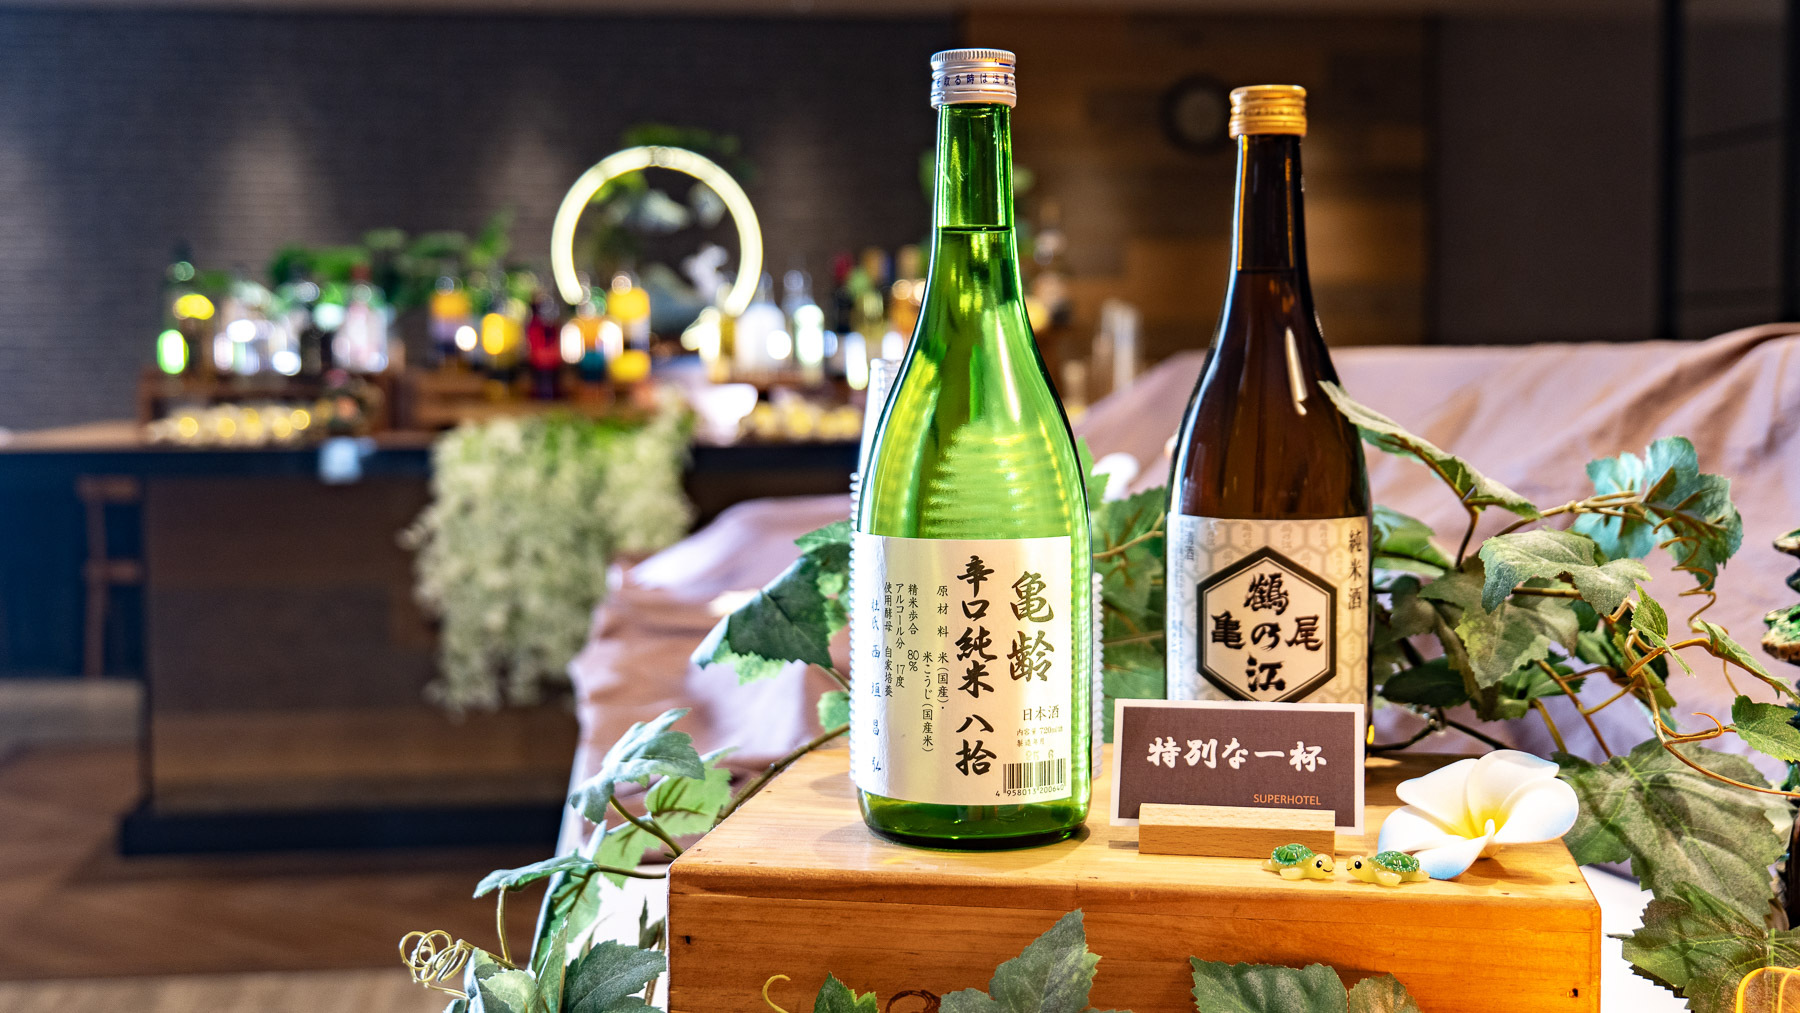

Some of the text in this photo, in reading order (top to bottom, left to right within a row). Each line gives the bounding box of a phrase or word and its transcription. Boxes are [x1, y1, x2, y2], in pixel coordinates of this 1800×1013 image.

[1348, 530, 1363, 610] 純米酒
[884, 582, 893, 698] 使用酵母 自家培養
[895, 583, 906, 689] アルコール分 17度
[907, 583, 920, 672] 精米歩合 80%
[936, 585, 949, 638] 原材料
[1006, 570, 1056, 683] 亀齢
[955, 555, 998, 777] 辛口純米 八拾
[1023, 704, 1060, 721] 日本酒
[1006, 787, 1037, 797] 958013
[1147, 736, 1328, 773] 特別な一杯
[1253, 793, 1322, 806] SUPERHOTEL
